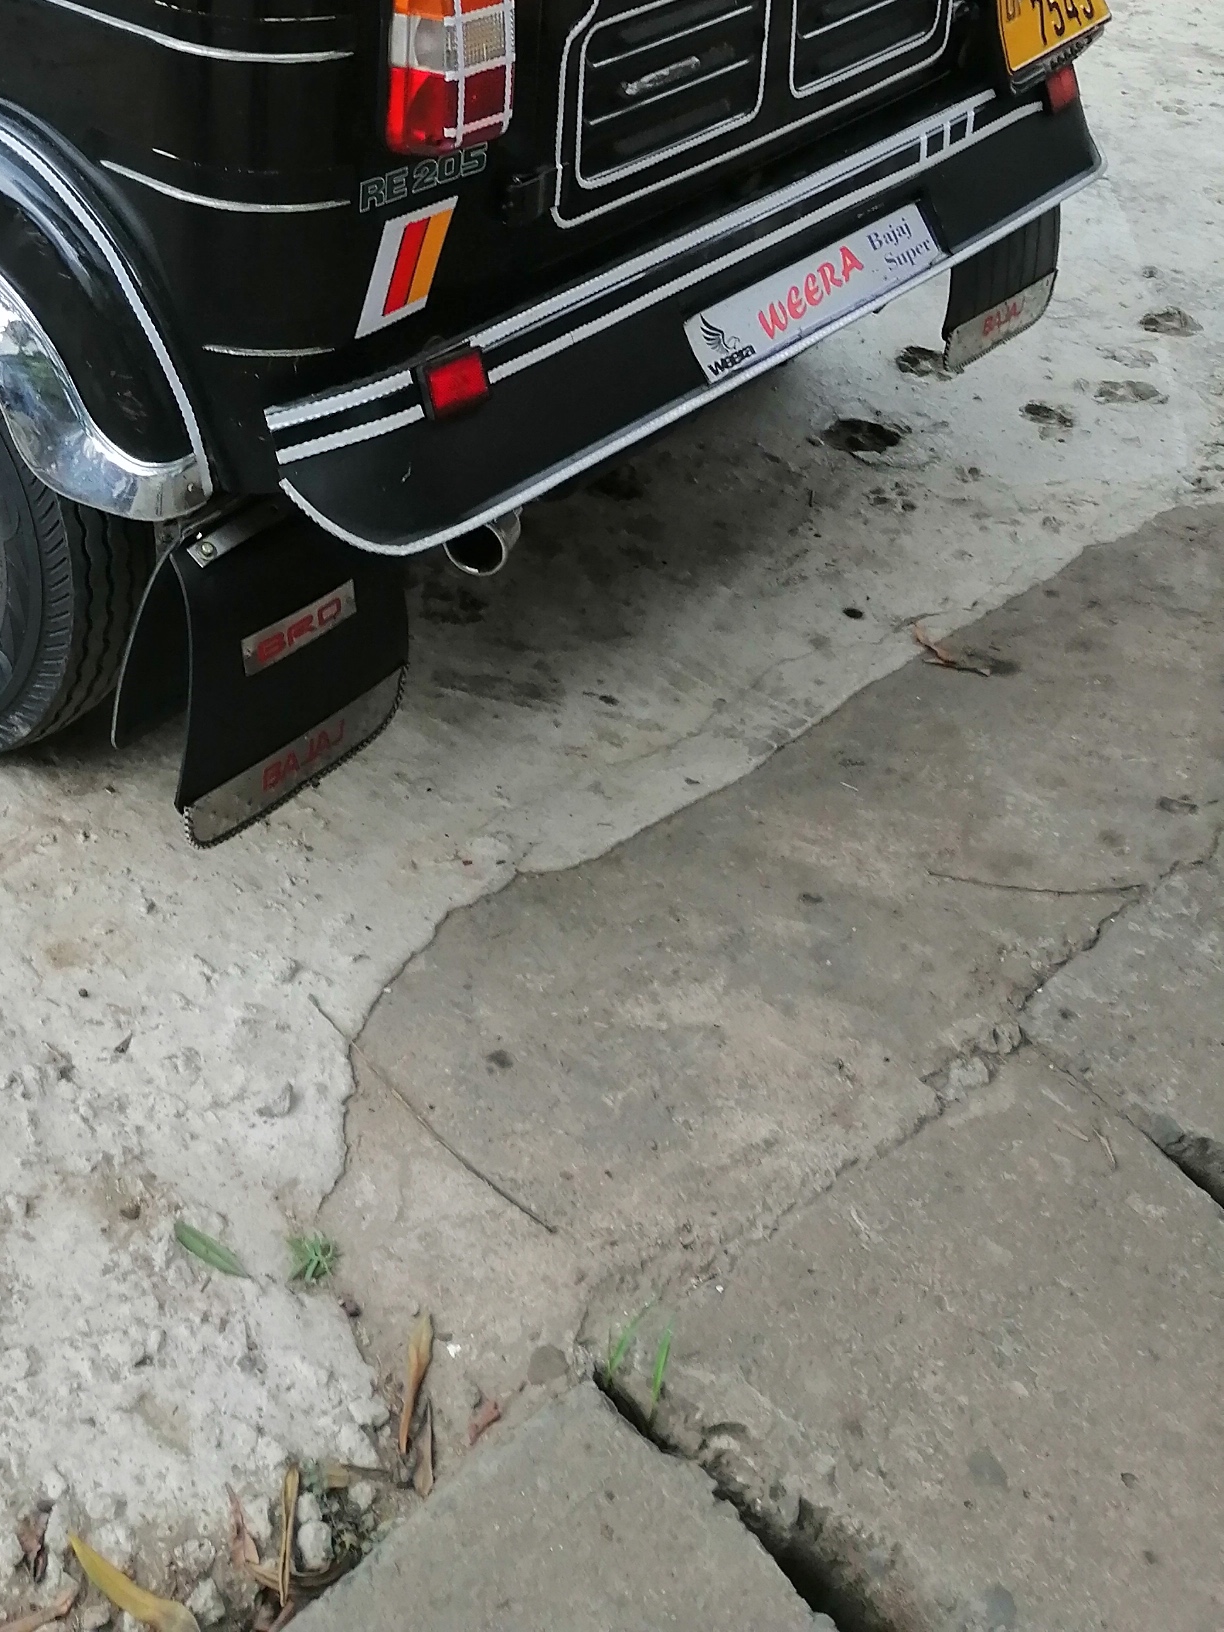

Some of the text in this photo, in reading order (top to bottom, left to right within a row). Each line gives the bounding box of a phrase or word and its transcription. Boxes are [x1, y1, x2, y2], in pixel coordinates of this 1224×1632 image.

[359, 141, 488, 213] RE 205
[866, 217, 913, 252] Bajaj
[884, 238, 930, 270] Super
[757, 245, 865, 340] WEERA
[262, 718, 345, 792] BAJAJ
